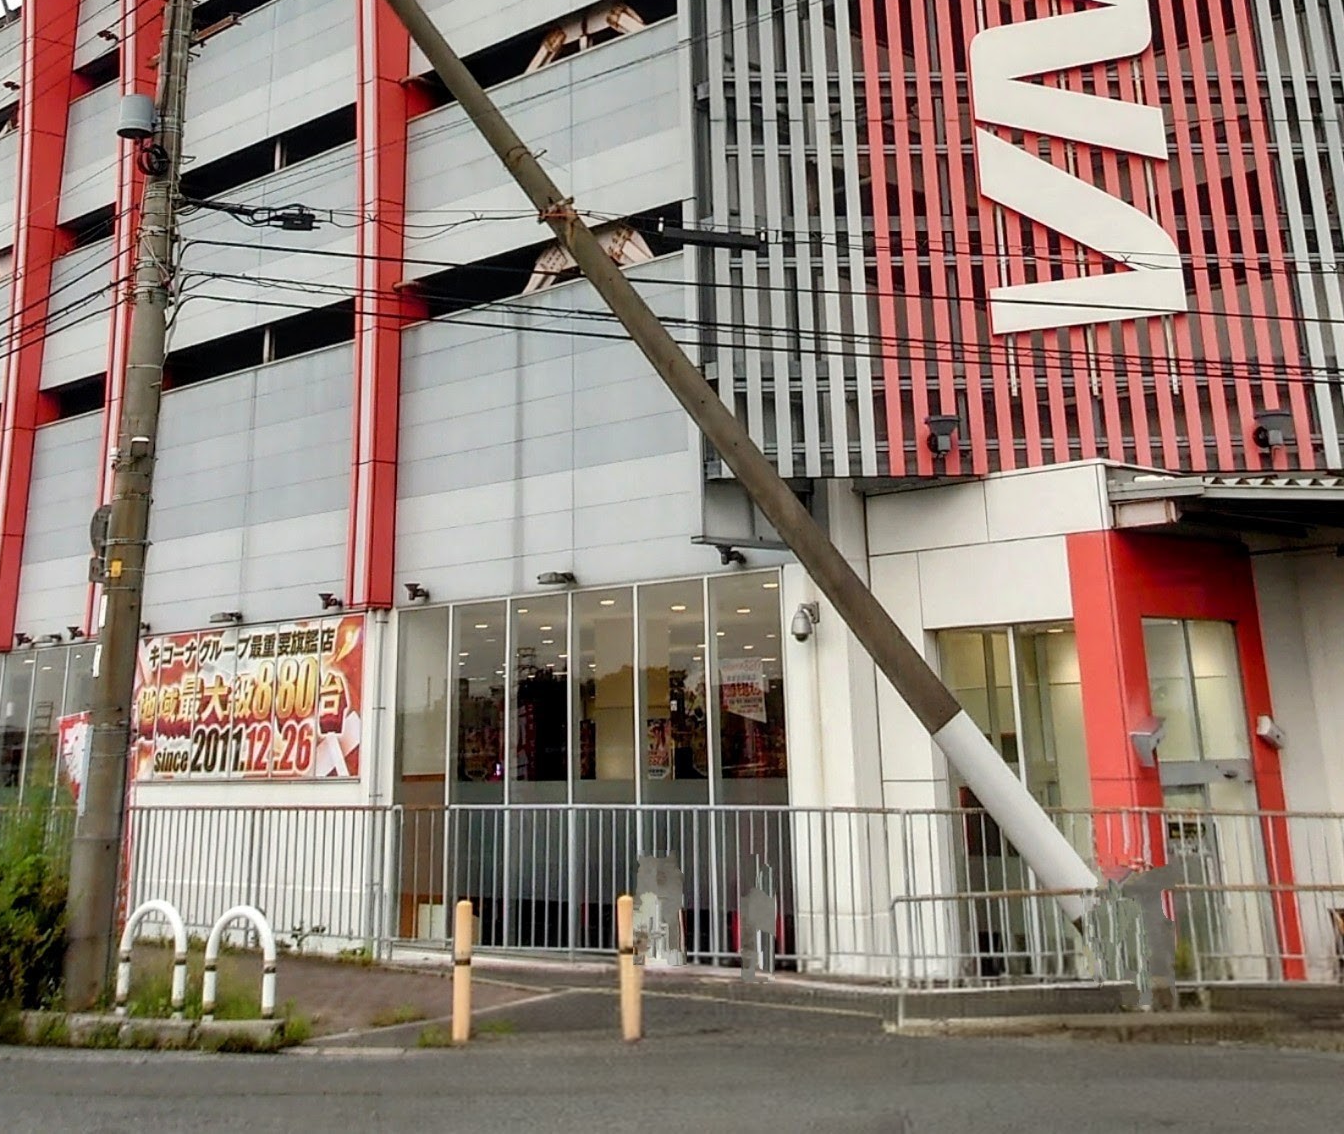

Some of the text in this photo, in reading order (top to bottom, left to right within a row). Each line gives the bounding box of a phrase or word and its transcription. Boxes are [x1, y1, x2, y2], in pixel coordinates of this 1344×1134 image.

[148, 626, 336, 670] キコーナグループ最重要旗艦店
[154, 748, 189, 773] since
